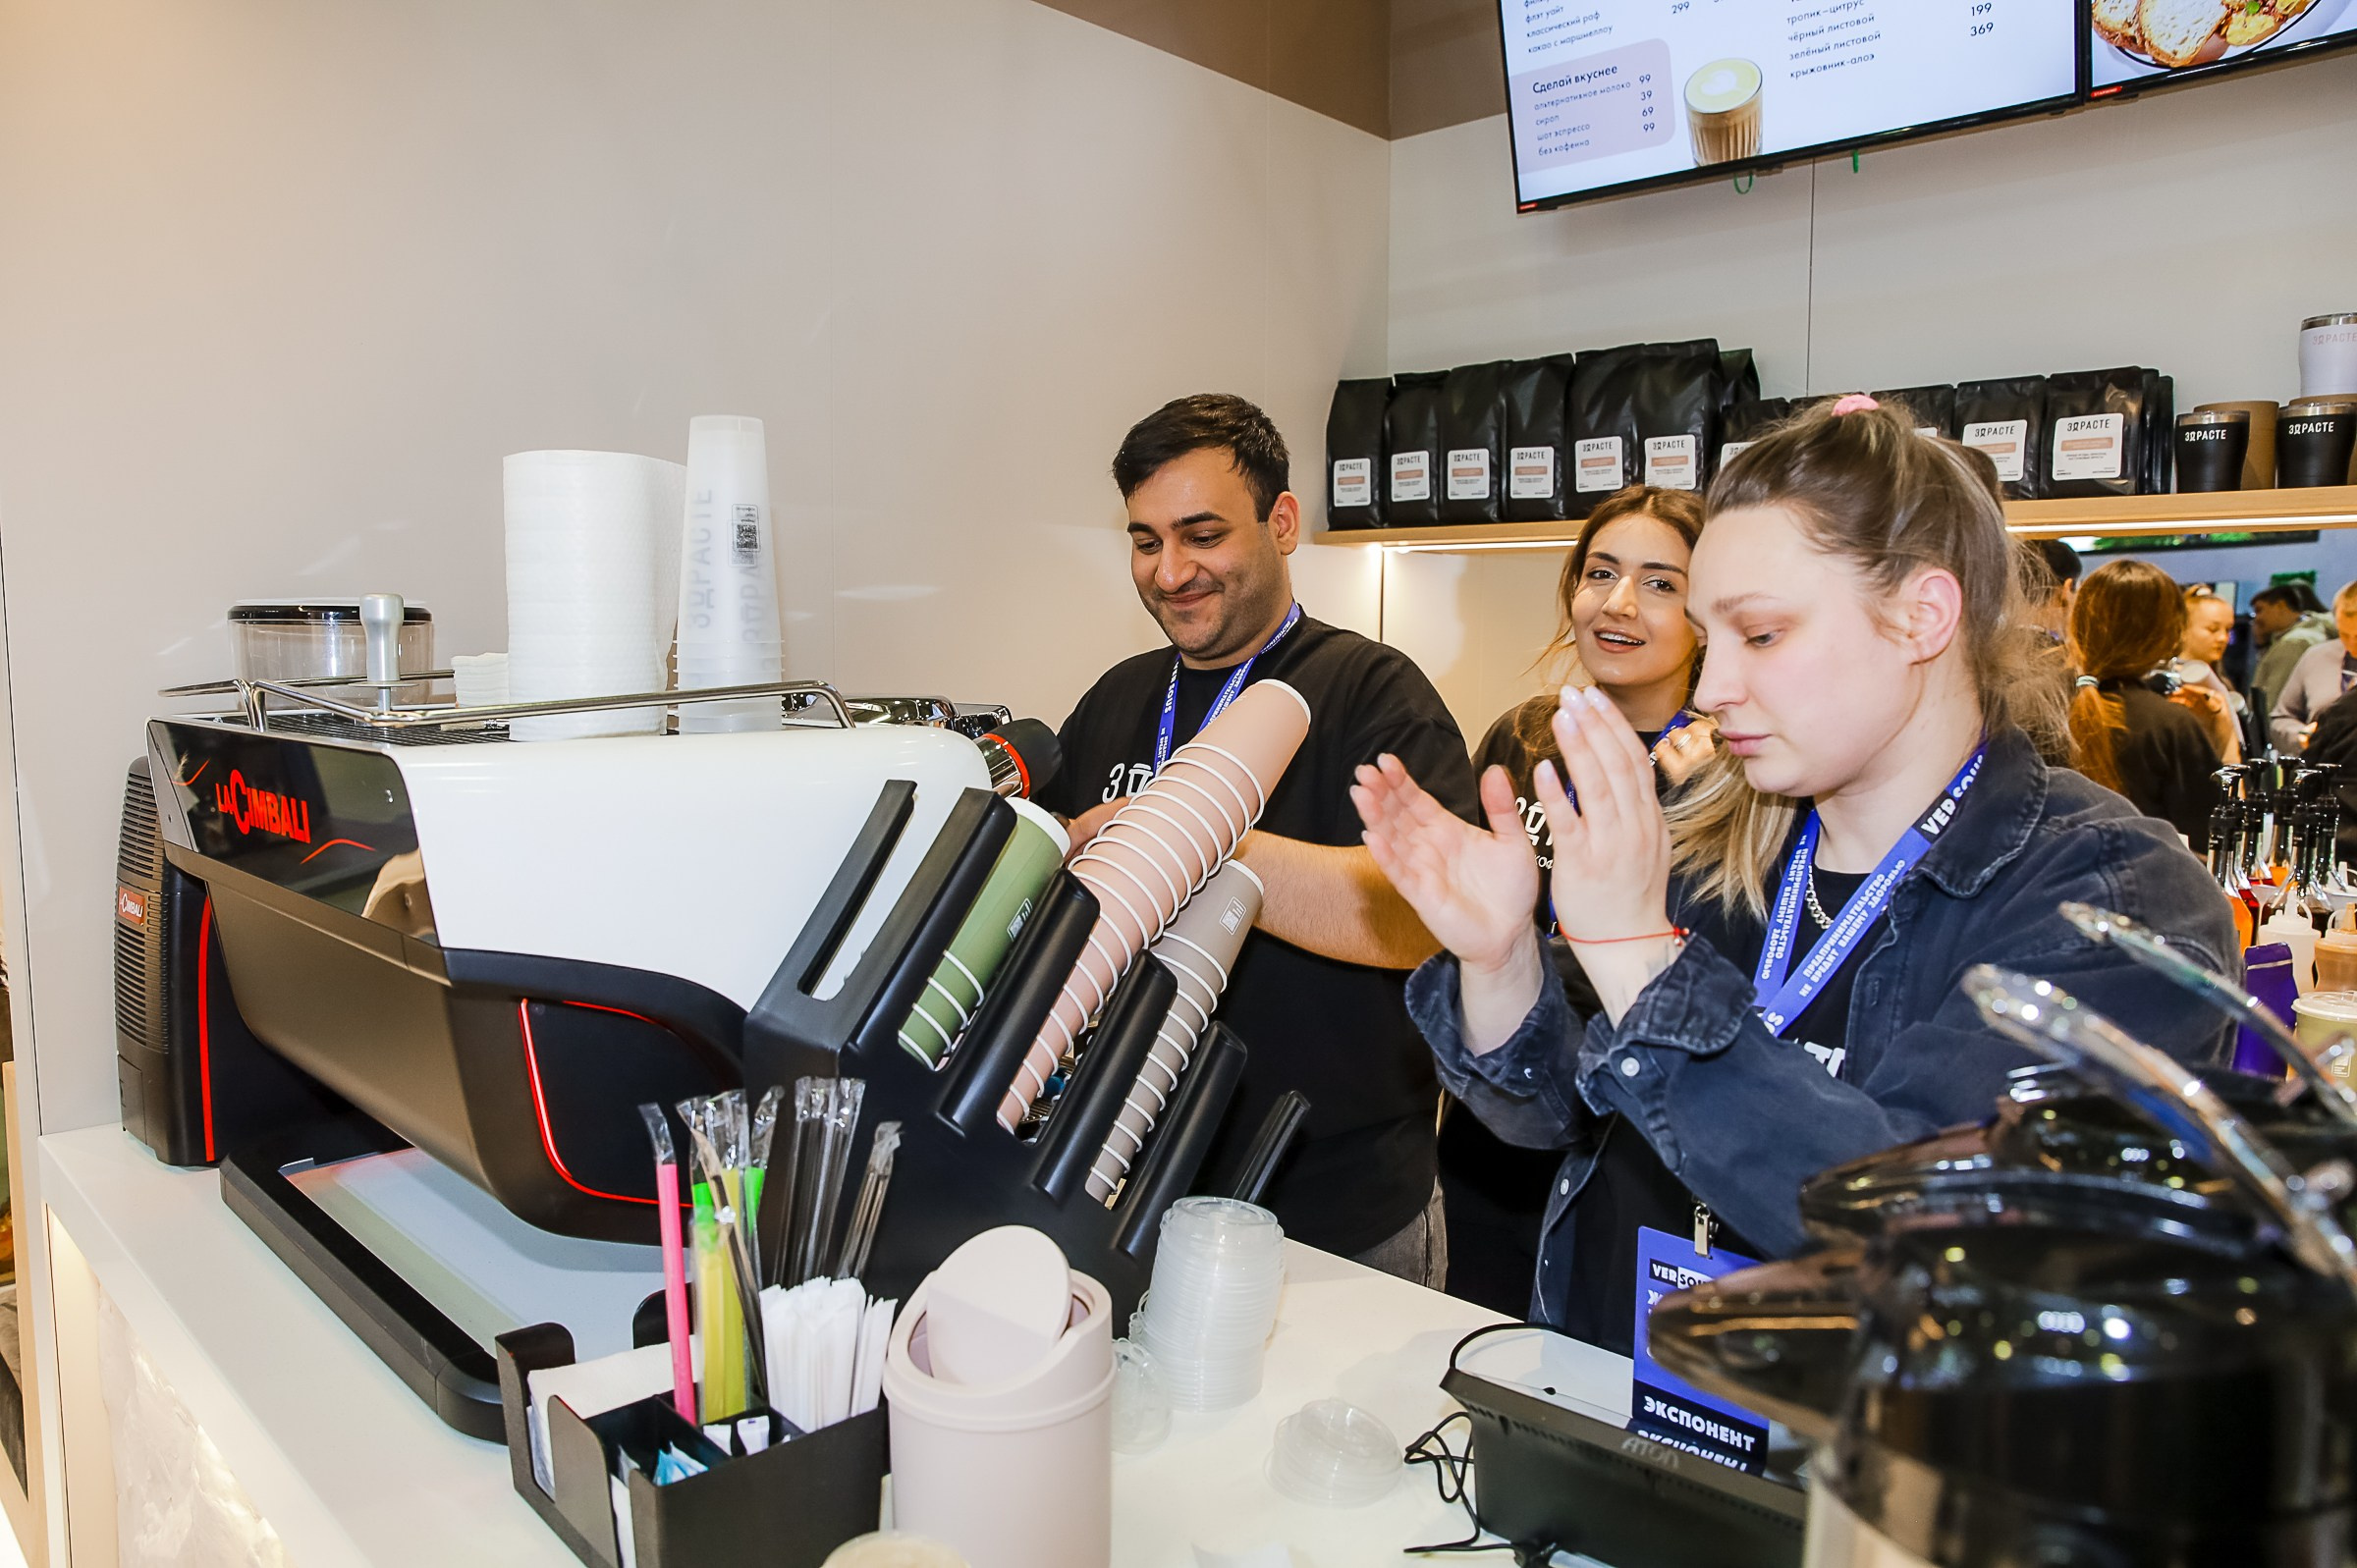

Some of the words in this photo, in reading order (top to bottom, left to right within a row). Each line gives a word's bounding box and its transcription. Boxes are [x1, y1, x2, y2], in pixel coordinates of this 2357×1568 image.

[1526, 12, 1543, 24] флэт
[1672, 1, 1689, 14] 299
[1971, 3, 1992, 17] 199
[1527, 18, 1580, 38] классический
[1583, 11, 1601, 25] раф
[1788, 27, 1825, 42] чёрный
[1828, 14, 1875, 33] листовой
[1970, 22, 1994, 37] 369
[1528, 41, 1552, 53] какао
[1561, 26, 1614, 45] маршмеллоу
[1789, 42, 1831, 61] зелёный
[1833, 30, 1881, 50] листовой
[1639, 74, 1651, 84] 99
[1789, 52, 1875, 80] крыжовник-алоэ
[1533, 75, 1571, 94] Сделай
[1574, 66, 1618, 83] вкуснее
[1535, 86, 1597, 110] альтернативное
[1600, 81, 1631, 94] молоко
[1640, 90, 1653, 101] 39
[1536, 115, 1560, 126] сироп
[1642, 106, 1654, 117] 69
[1537, 132, 1553, 141] шот
[1555, 124, 1591, 137] эспрессо
[1643, 123, 1655, 133] 99
[1538, 146, 1553, 156] без
[1776, 847, 1809, 959] ПРЕДПРИНИМАТЕЛЬСТВО
[1776, 886, 1792, 924] ВАШЕМУ
[1798, 983, 1813, 998] НЕ
[1811, 947, 1839, 983] ВРЕДИТ
[1837, 910, 1869, 948] ВАШЕМУ
[1867, 859, 1905, 909] ЗДОРОВЬЮ
[1802, 874, 1886, 978] ПРЕДПРИНИМАТЕЛЬСТВО
[1761, 928, 1781, 980] ЗДОРОВЬЮ
[1643, 1395, 1755, 1451] ЭКСПОНЕНТ
